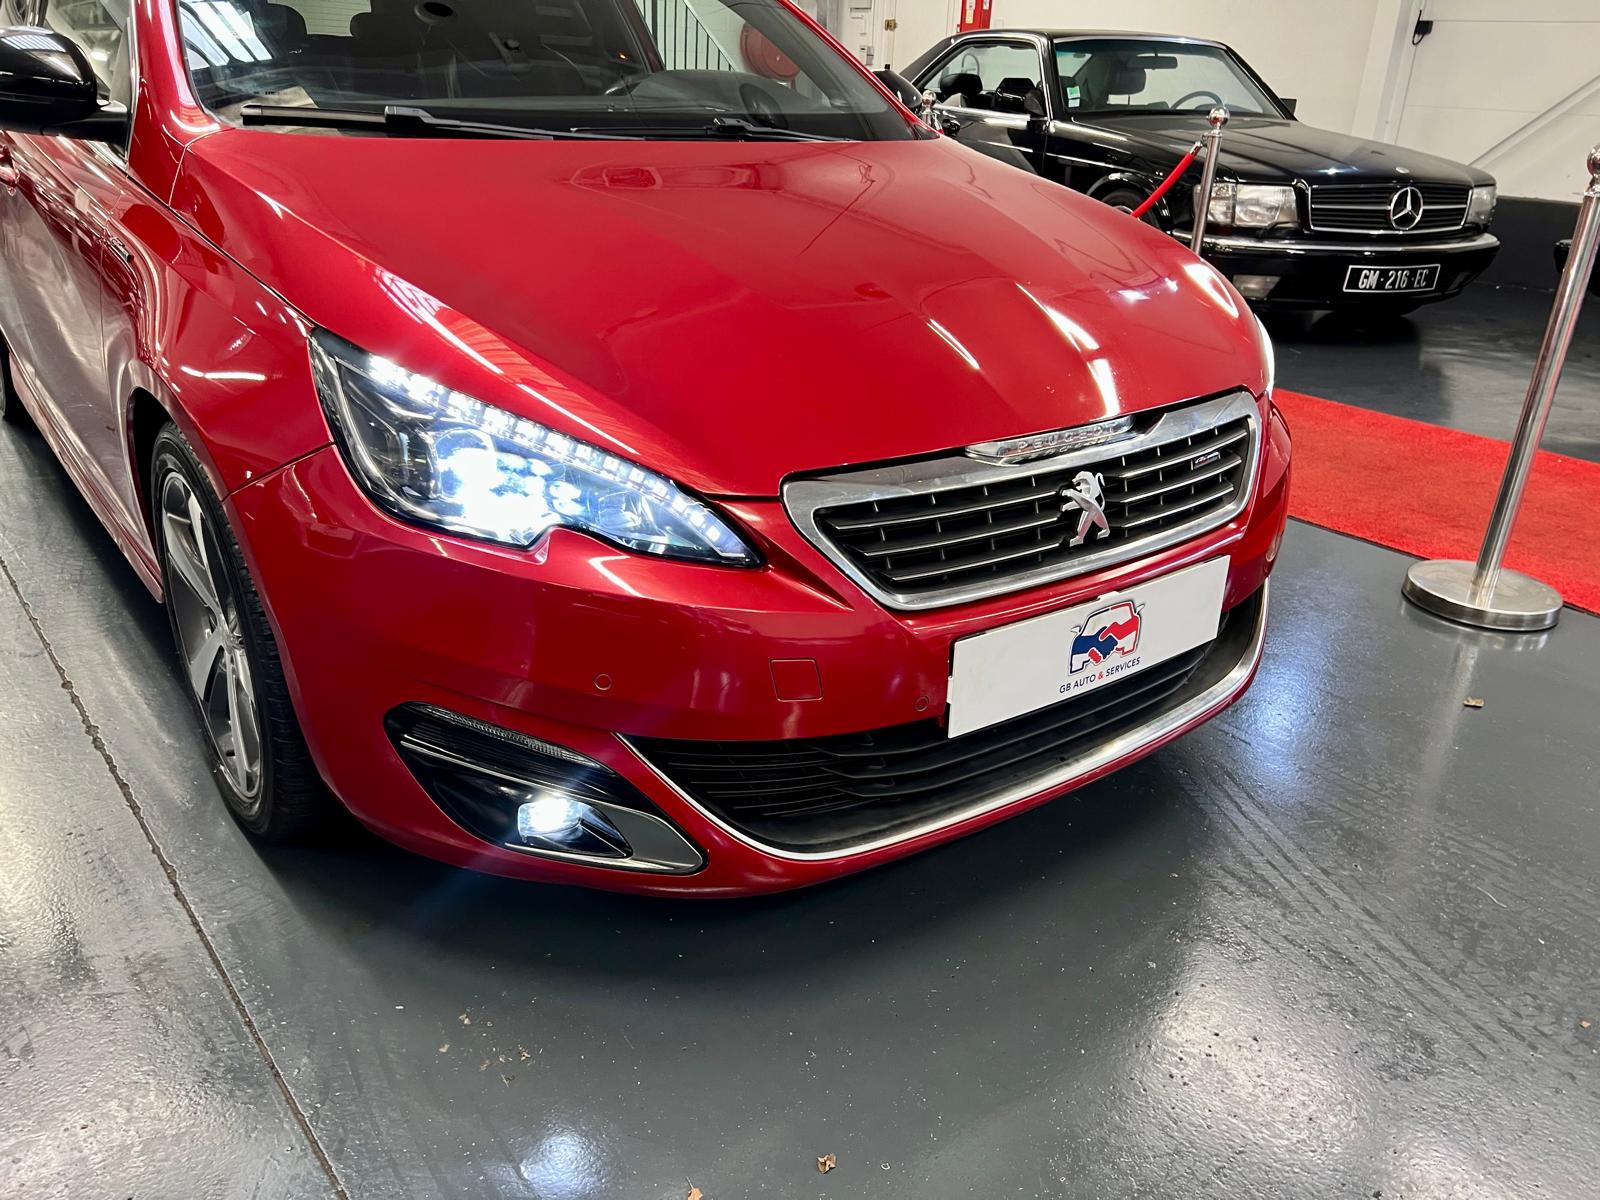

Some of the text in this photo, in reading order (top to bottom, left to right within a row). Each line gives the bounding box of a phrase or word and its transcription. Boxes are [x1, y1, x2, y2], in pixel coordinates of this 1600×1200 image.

[1059, 656, 1141, 693] GB AUTO & SERVICES
